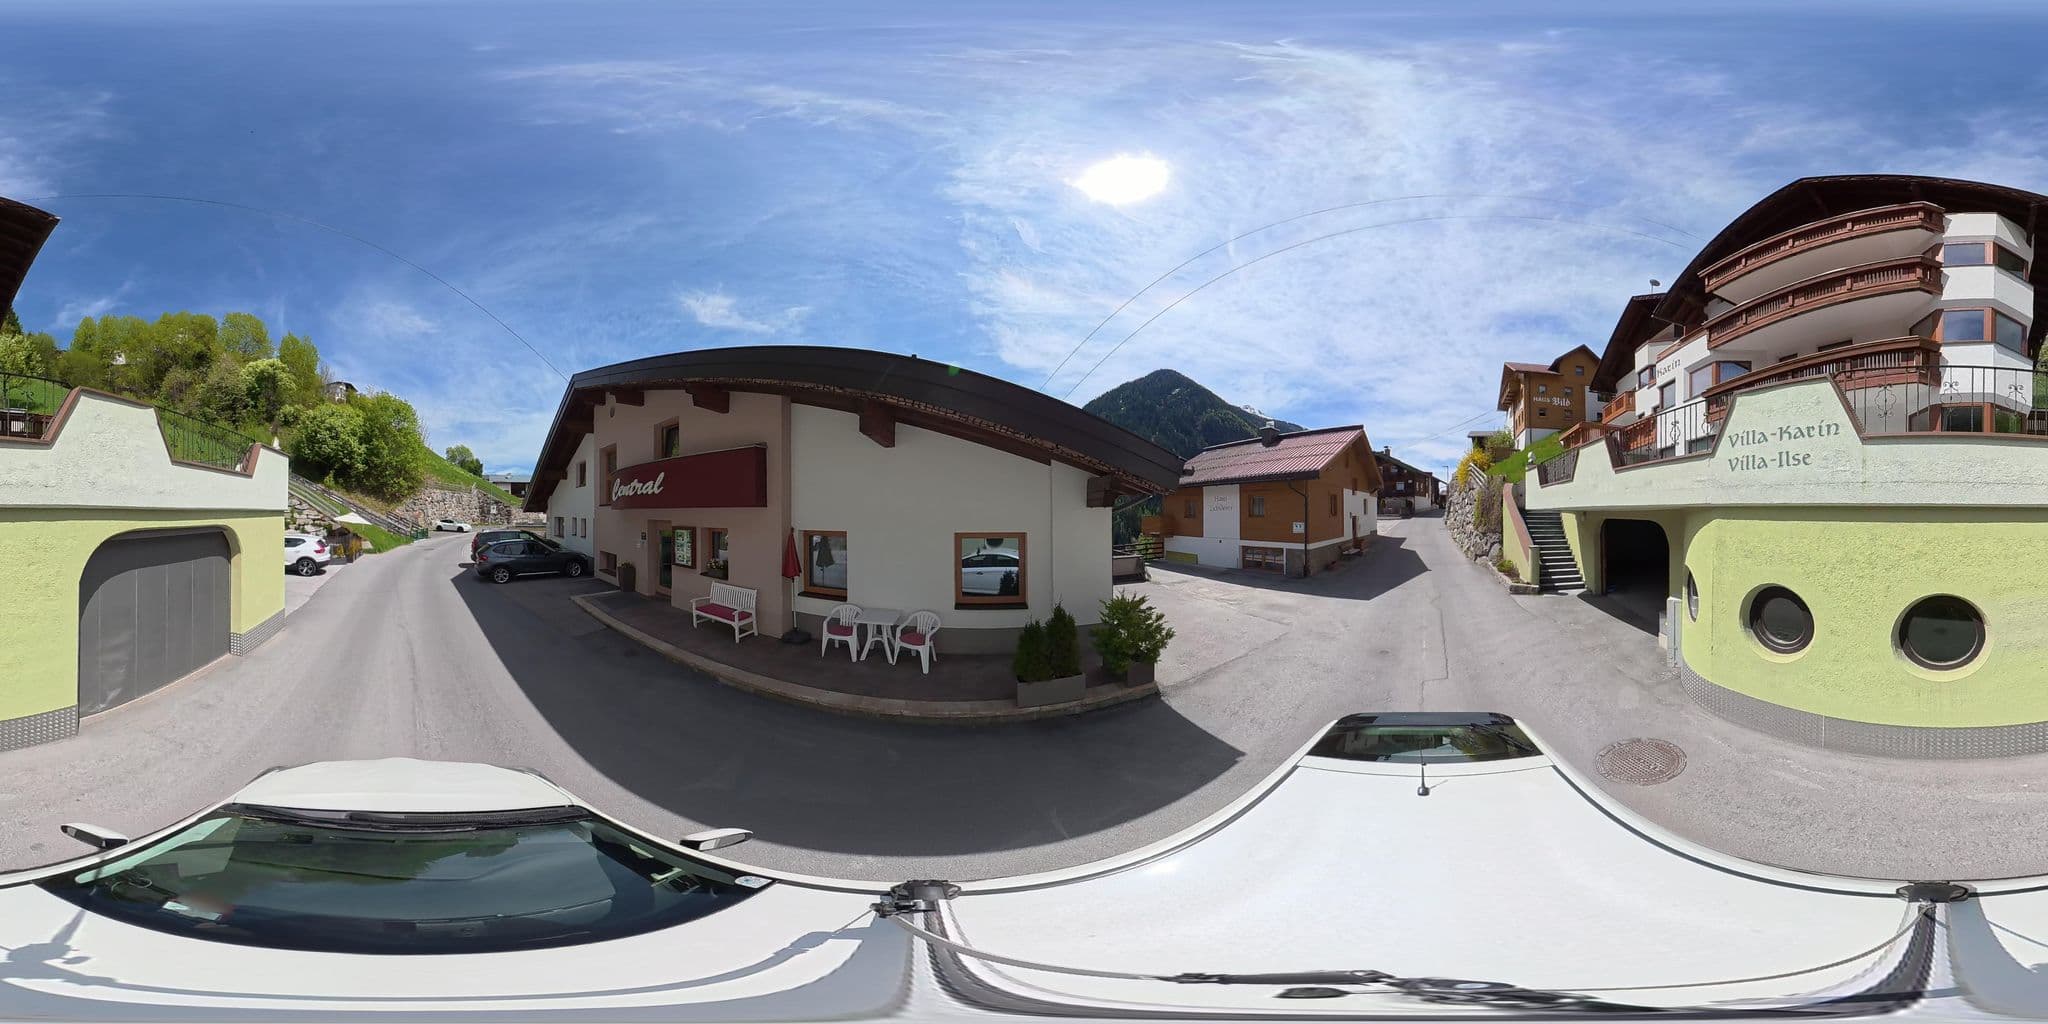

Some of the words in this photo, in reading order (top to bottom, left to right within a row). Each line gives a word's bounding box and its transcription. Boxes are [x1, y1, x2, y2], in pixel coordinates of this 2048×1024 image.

[1656, 359, 1681, 379] Karin
[1728, 420, 1840, 448] Villa-Karin
[1728, 451, 1812, 472] Villa-Ilse
[612, 471, 665, 502] Central
